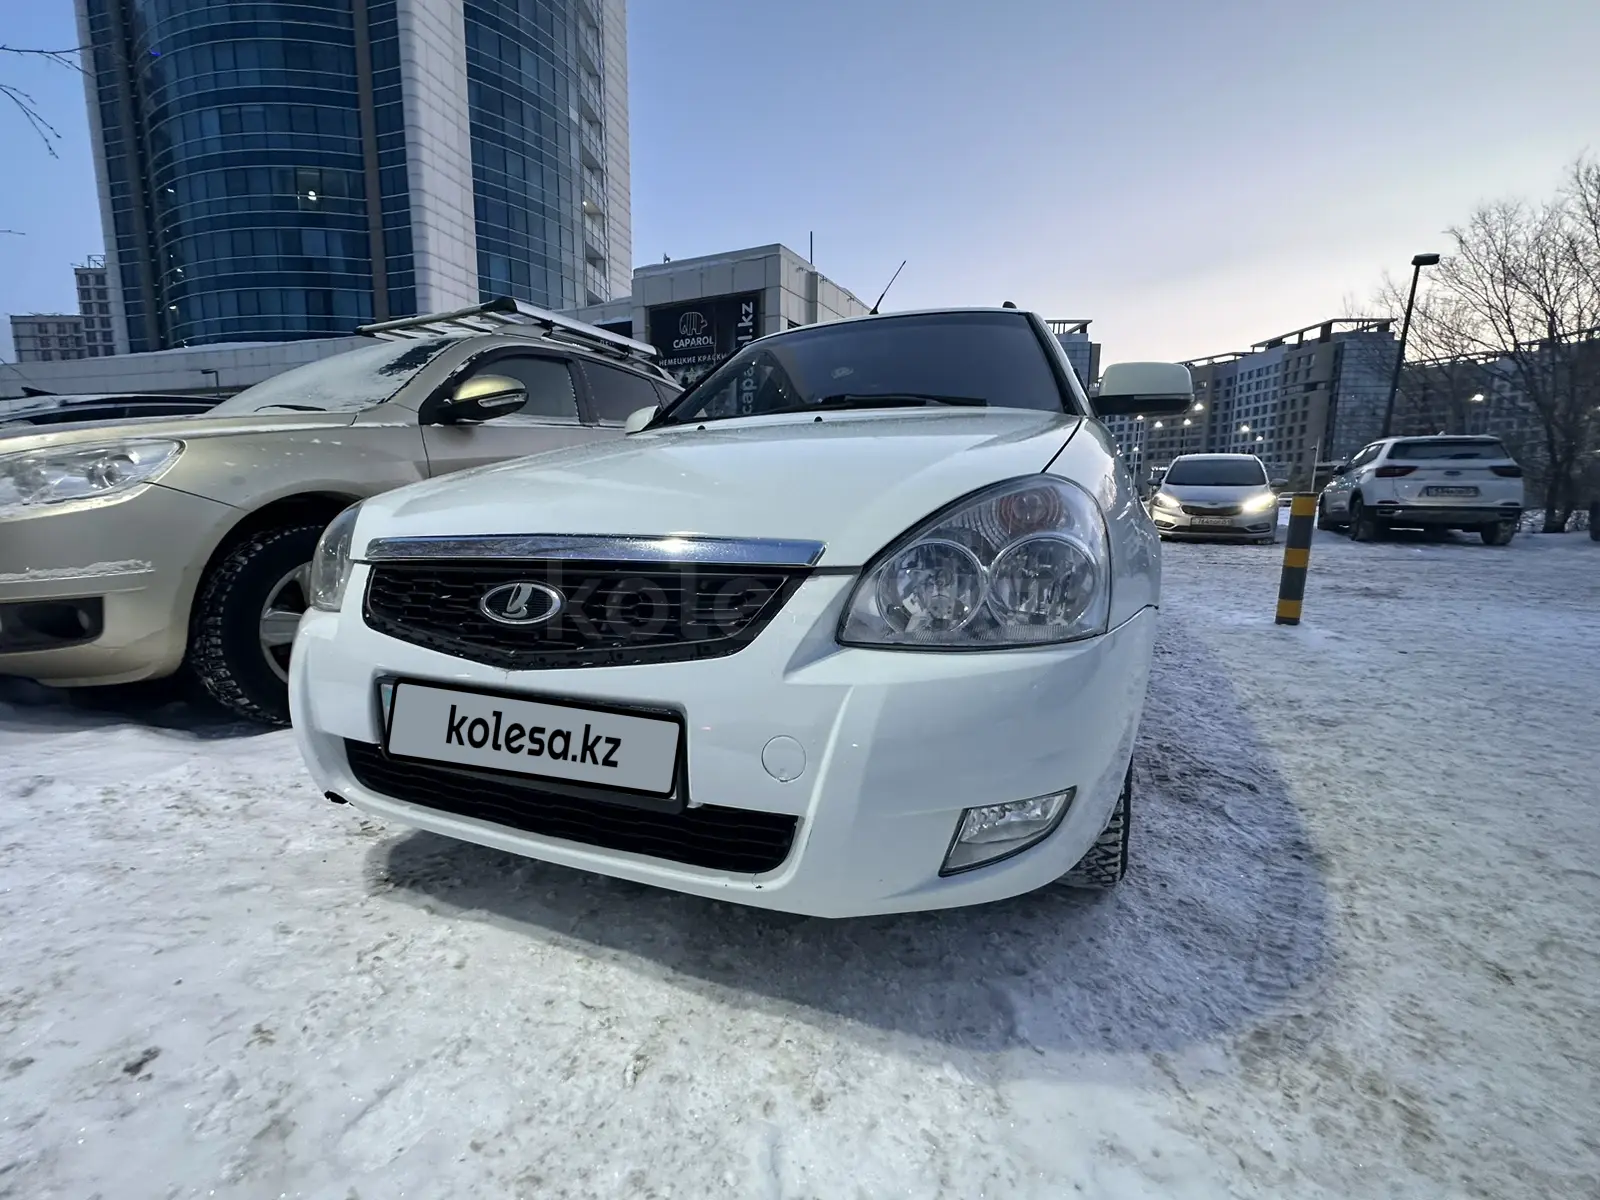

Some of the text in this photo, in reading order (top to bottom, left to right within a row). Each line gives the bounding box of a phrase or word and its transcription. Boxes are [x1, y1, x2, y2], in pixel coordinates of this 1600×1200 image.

[673, 335, 714, 349] CAPAROL
[658, 352, 727, 366] НЕМЕЦКИЕ КРАСКИ
